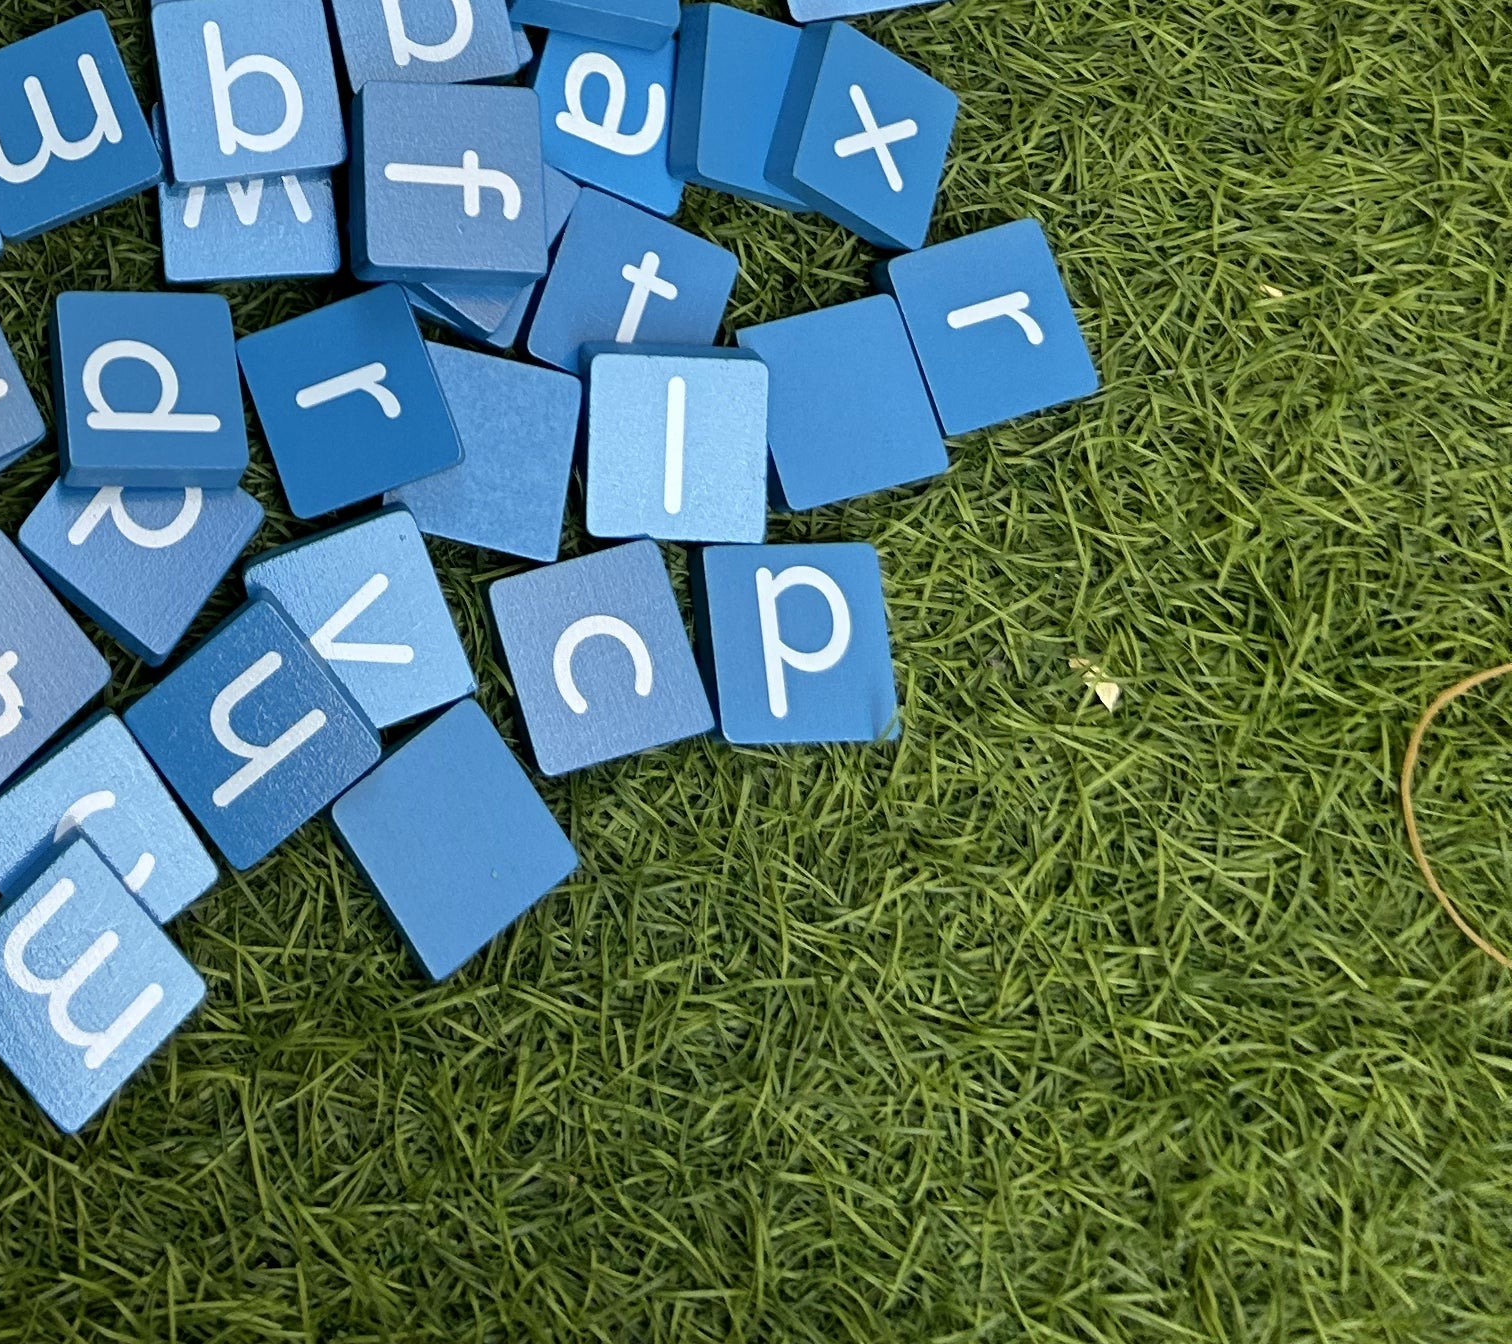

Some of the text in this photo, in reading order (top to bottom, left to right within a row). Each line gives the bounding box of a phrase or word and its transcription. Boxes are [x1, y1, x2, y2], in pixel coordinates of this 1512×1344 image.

[202, 20, 304, 156] b
[834, 84, 918, 192] x
[755, 565, 851, 718] p
